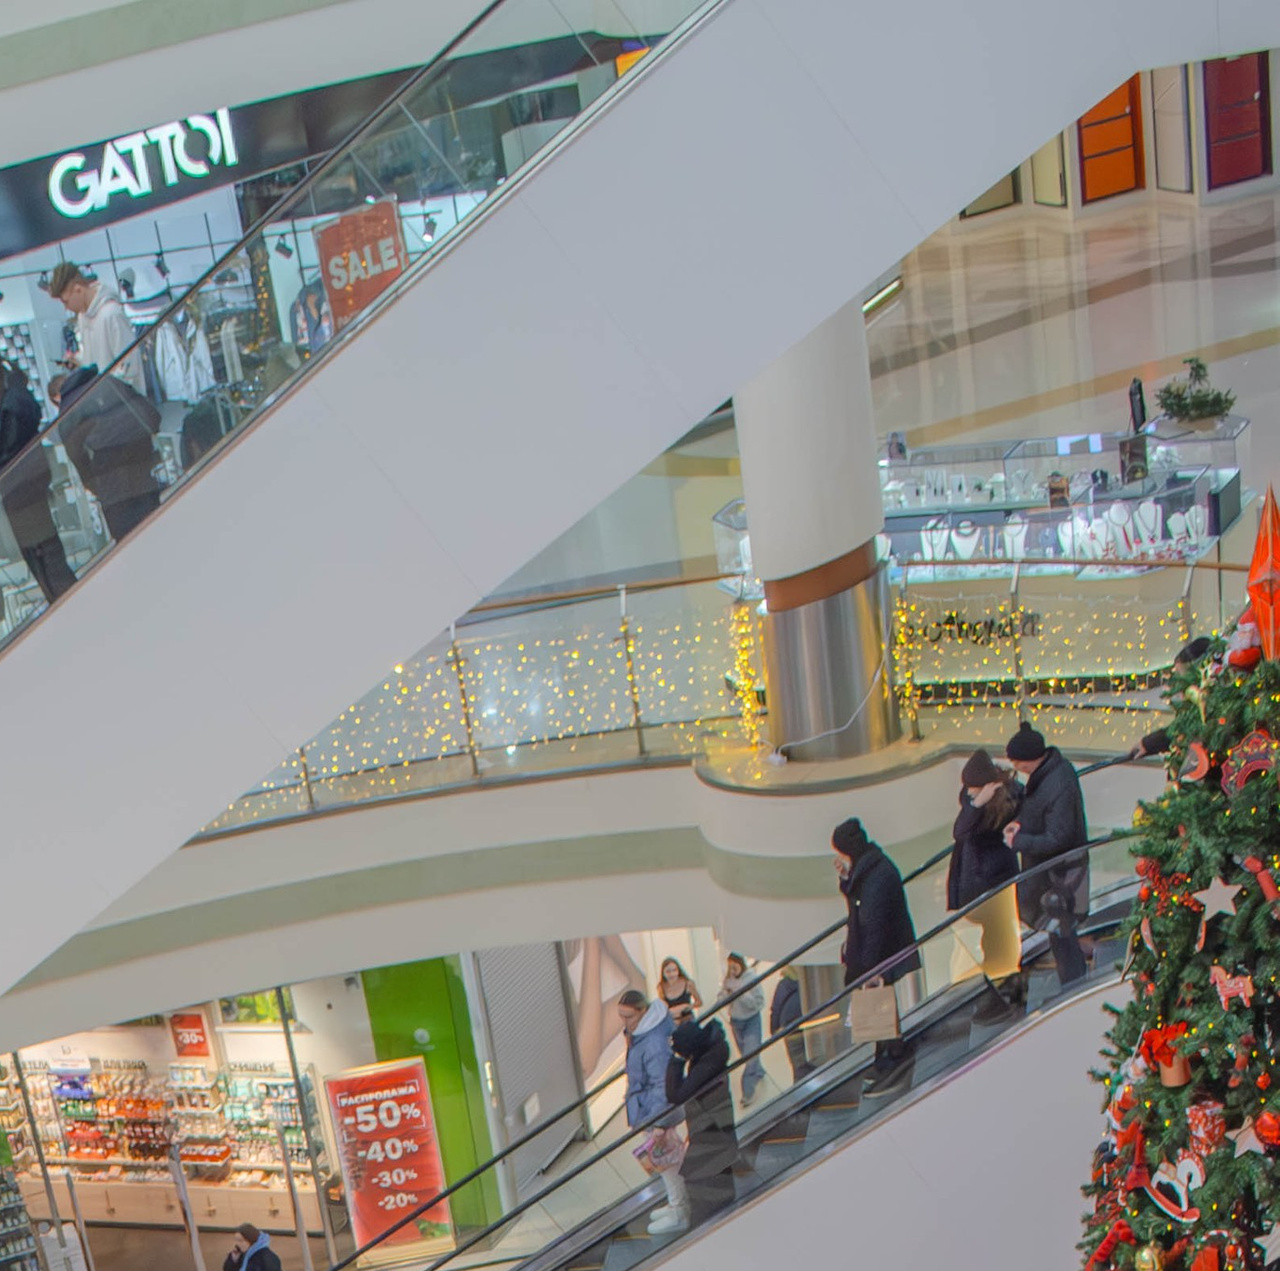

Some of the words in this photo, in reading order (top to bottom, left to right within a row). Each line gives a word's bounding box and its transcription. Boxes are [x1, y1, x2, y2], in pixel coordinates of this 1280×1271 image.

[328, 237, 398, 291] SALE
[340, 1085, 417, 1107] РАСПРОДАЖА
[344, 1100, 421, 1133] -50%
[357, 1138, 419, 1163] -40%
[371, 1168, 418, 1189] -30%
[378, 1192, 418, 1211] -20%
